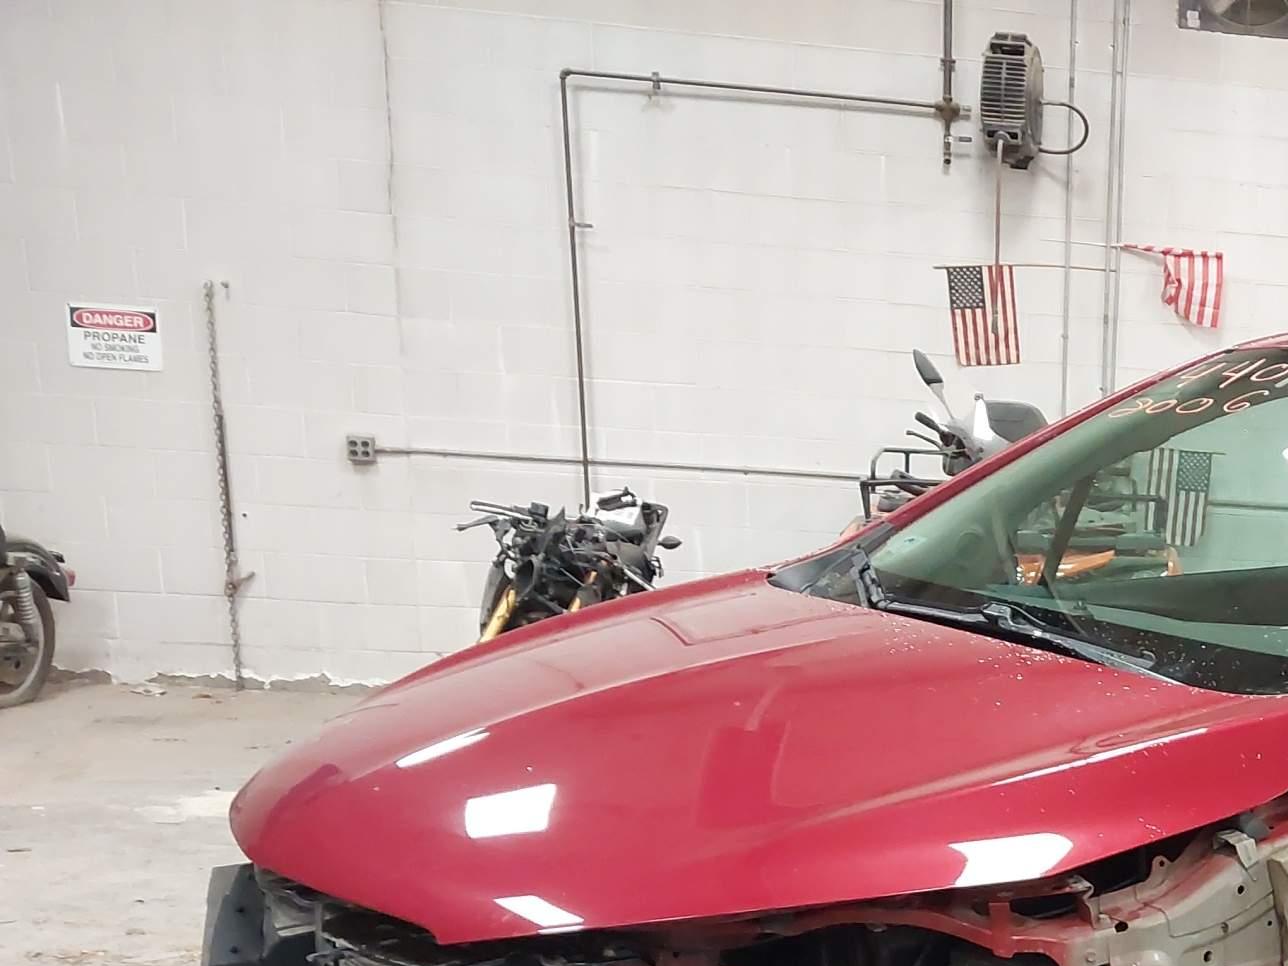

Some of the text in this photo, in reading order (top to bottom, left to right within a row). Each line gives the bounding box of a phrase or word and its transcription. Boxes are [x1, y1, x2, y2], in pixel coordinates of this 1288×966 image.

[81, 312, 144, 328] DANGER
[83, 330, 146, 344] PROPANE
[91, 343, 102, 351] NO
